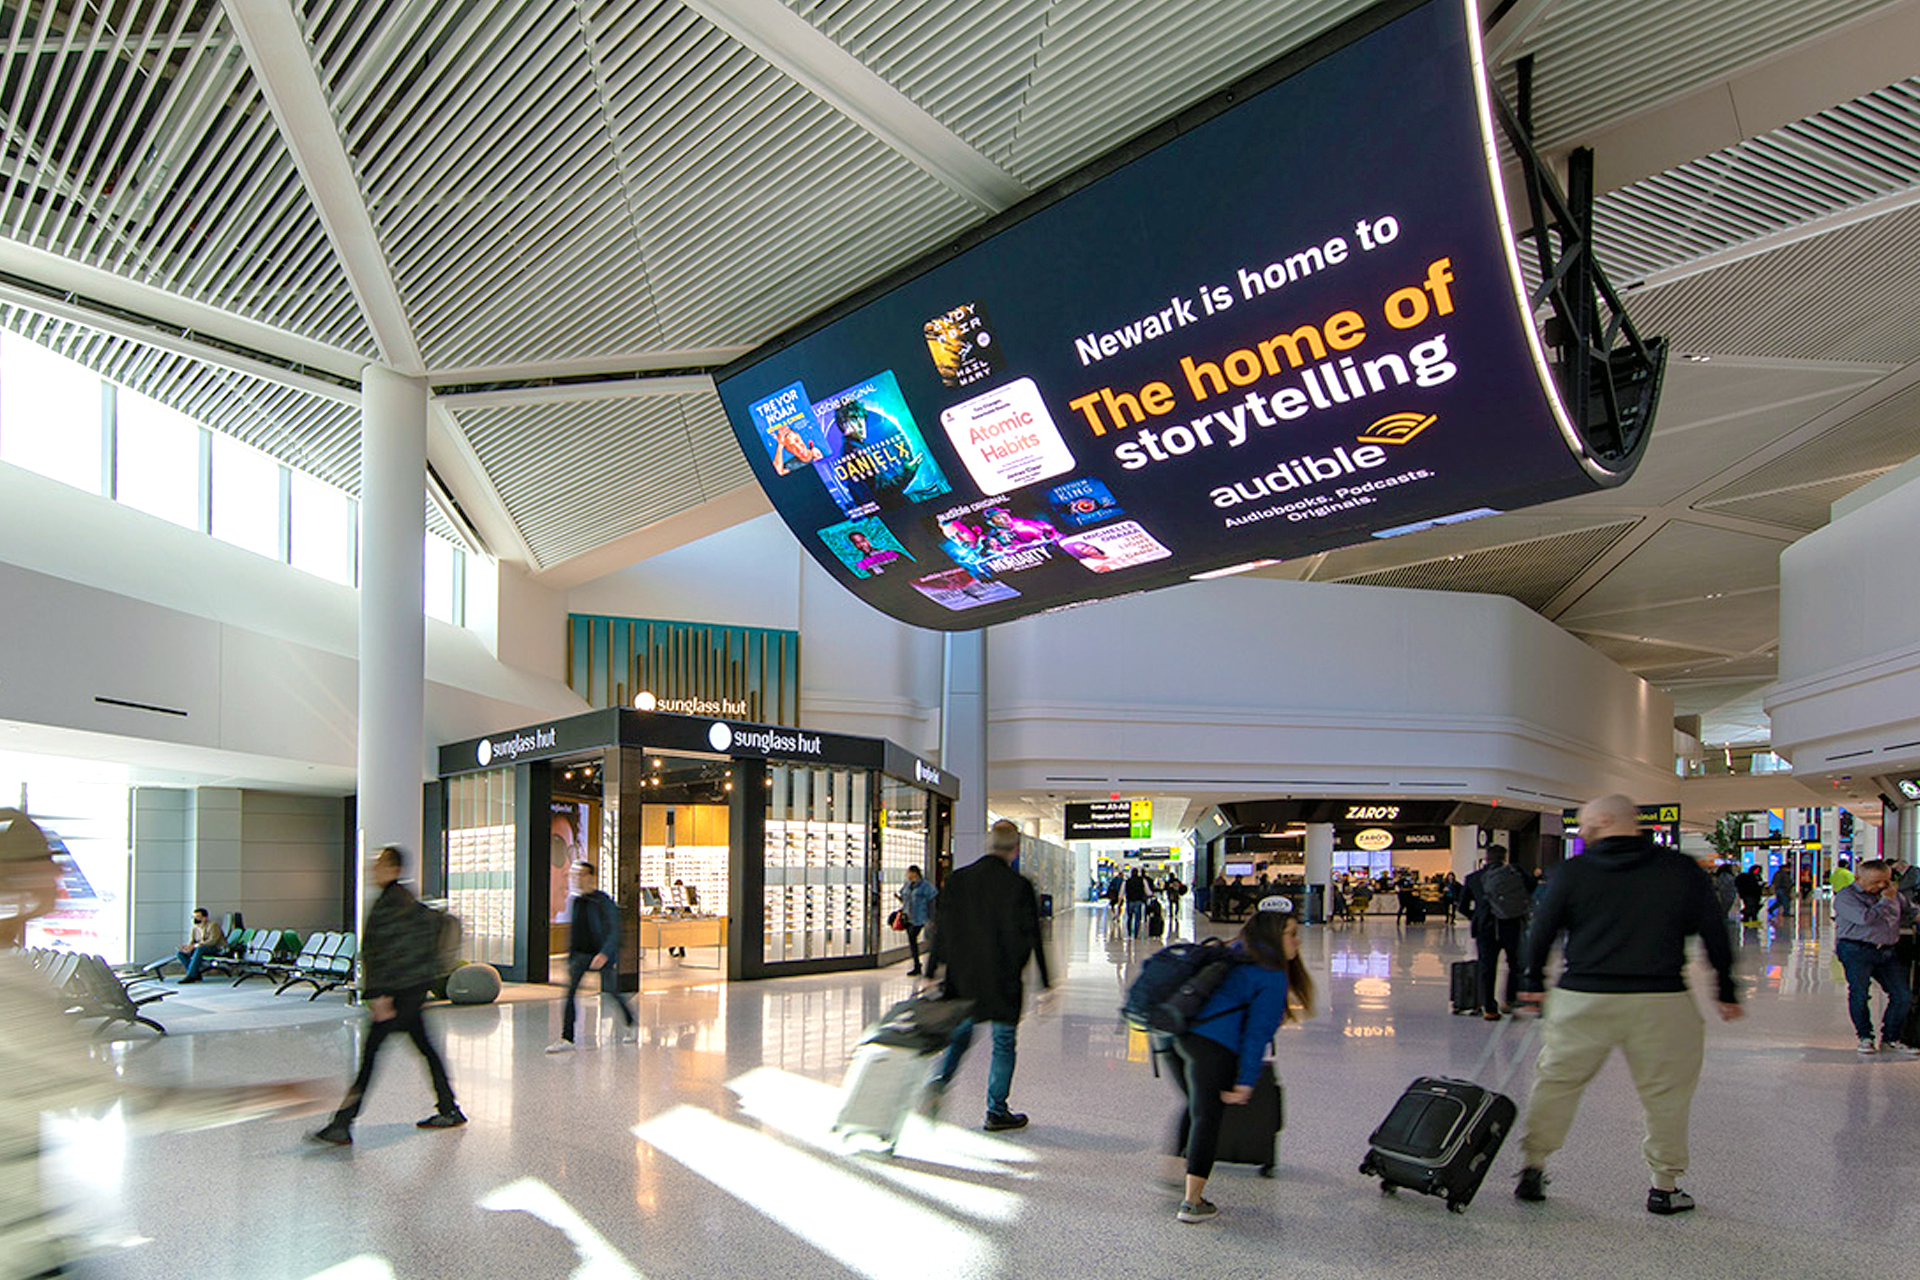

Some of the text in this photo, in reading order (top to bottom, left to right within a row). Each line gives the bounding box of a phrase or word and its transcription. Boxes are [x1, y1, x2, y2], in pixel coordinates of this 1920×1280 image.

[1074, 214, 1400, 366] Newark is home to
[933, 303, 975, 331] ANDY
[1069, 256, 1455, 438] The home of
[956, 360, 989, 377] HAIL
[959, 367, 991, 386] MARY
[756, 389, 799, 417] TREVOR
[766, 402, 797, 424] NOAH
[1114, 333, 1457, 470] storytelling
[969, 411, 1034, 445] Atomic
[834, 440, 910, 481] DANIEL X
[980, 433, 1041, 463] Habits
[1209, 443, 1388, 508] audible
[1056, 485, 1094, 501] KING
[1224, 467, 1436, 529] Audiobooks. Podcasts.
[1288, 494, 1378, 523] Originals.
[1082, 523, 1136, 540] MICHELLE
[987, 545, 1052, 573] MORIARTY
[657, 696, 748, 716] sunglass hut
[492, 727, 557, 759] sunglass hut
[734, 729, 821, 755] sunglass hut
[1345, 806, 1400, 820] ZARO'S
[1664, 809, 1675, 819] A
